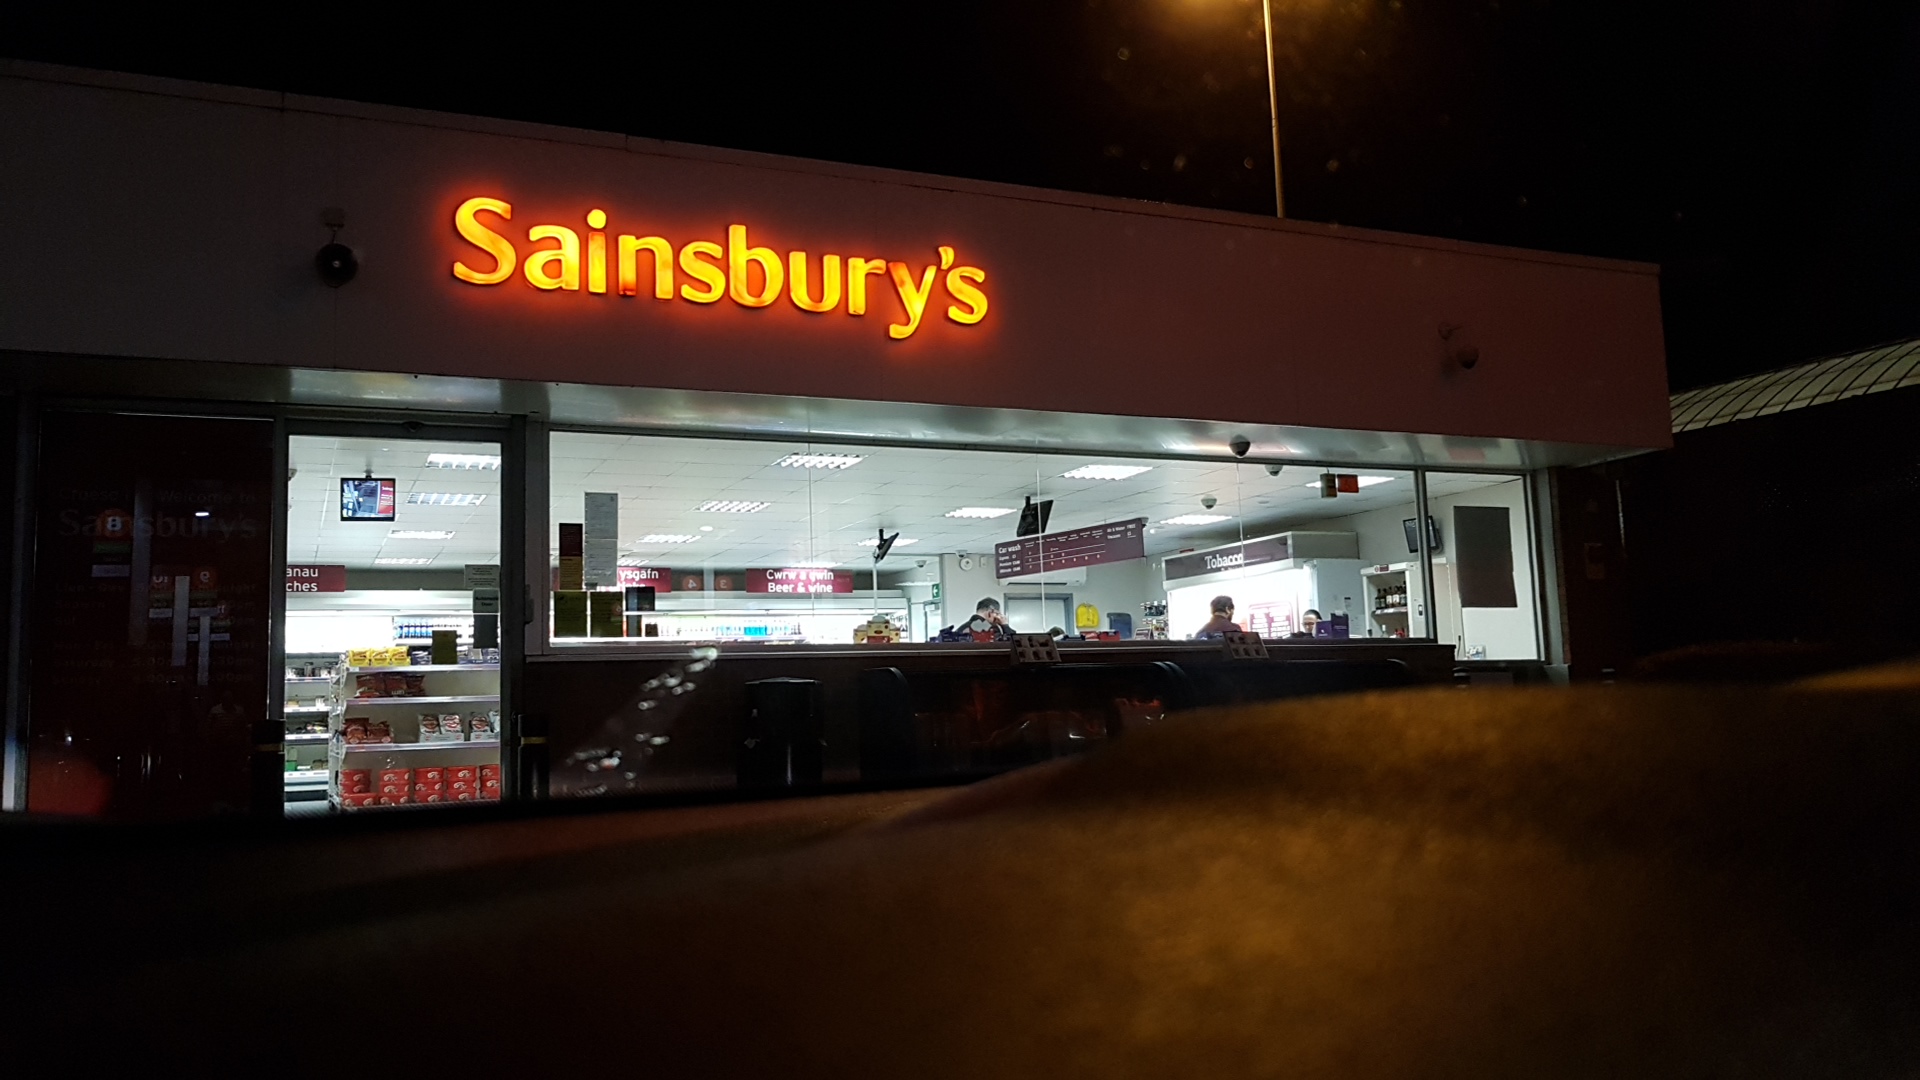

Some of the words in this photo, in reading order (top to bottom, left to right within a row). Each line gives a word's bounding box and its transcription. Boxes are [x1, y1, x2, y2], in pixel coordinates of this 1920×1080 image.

[453, 196, 989, 340] Sainsbury's
[1204, 553, 1244, 569] Tobacco
[619, 568, 659, 580] ysgafn
[286, 581, 318, 592] ches
[768, 582, 794, 592] Beer
[797, 582, 805, 592] &
[808, 582, 833, 592] wine
